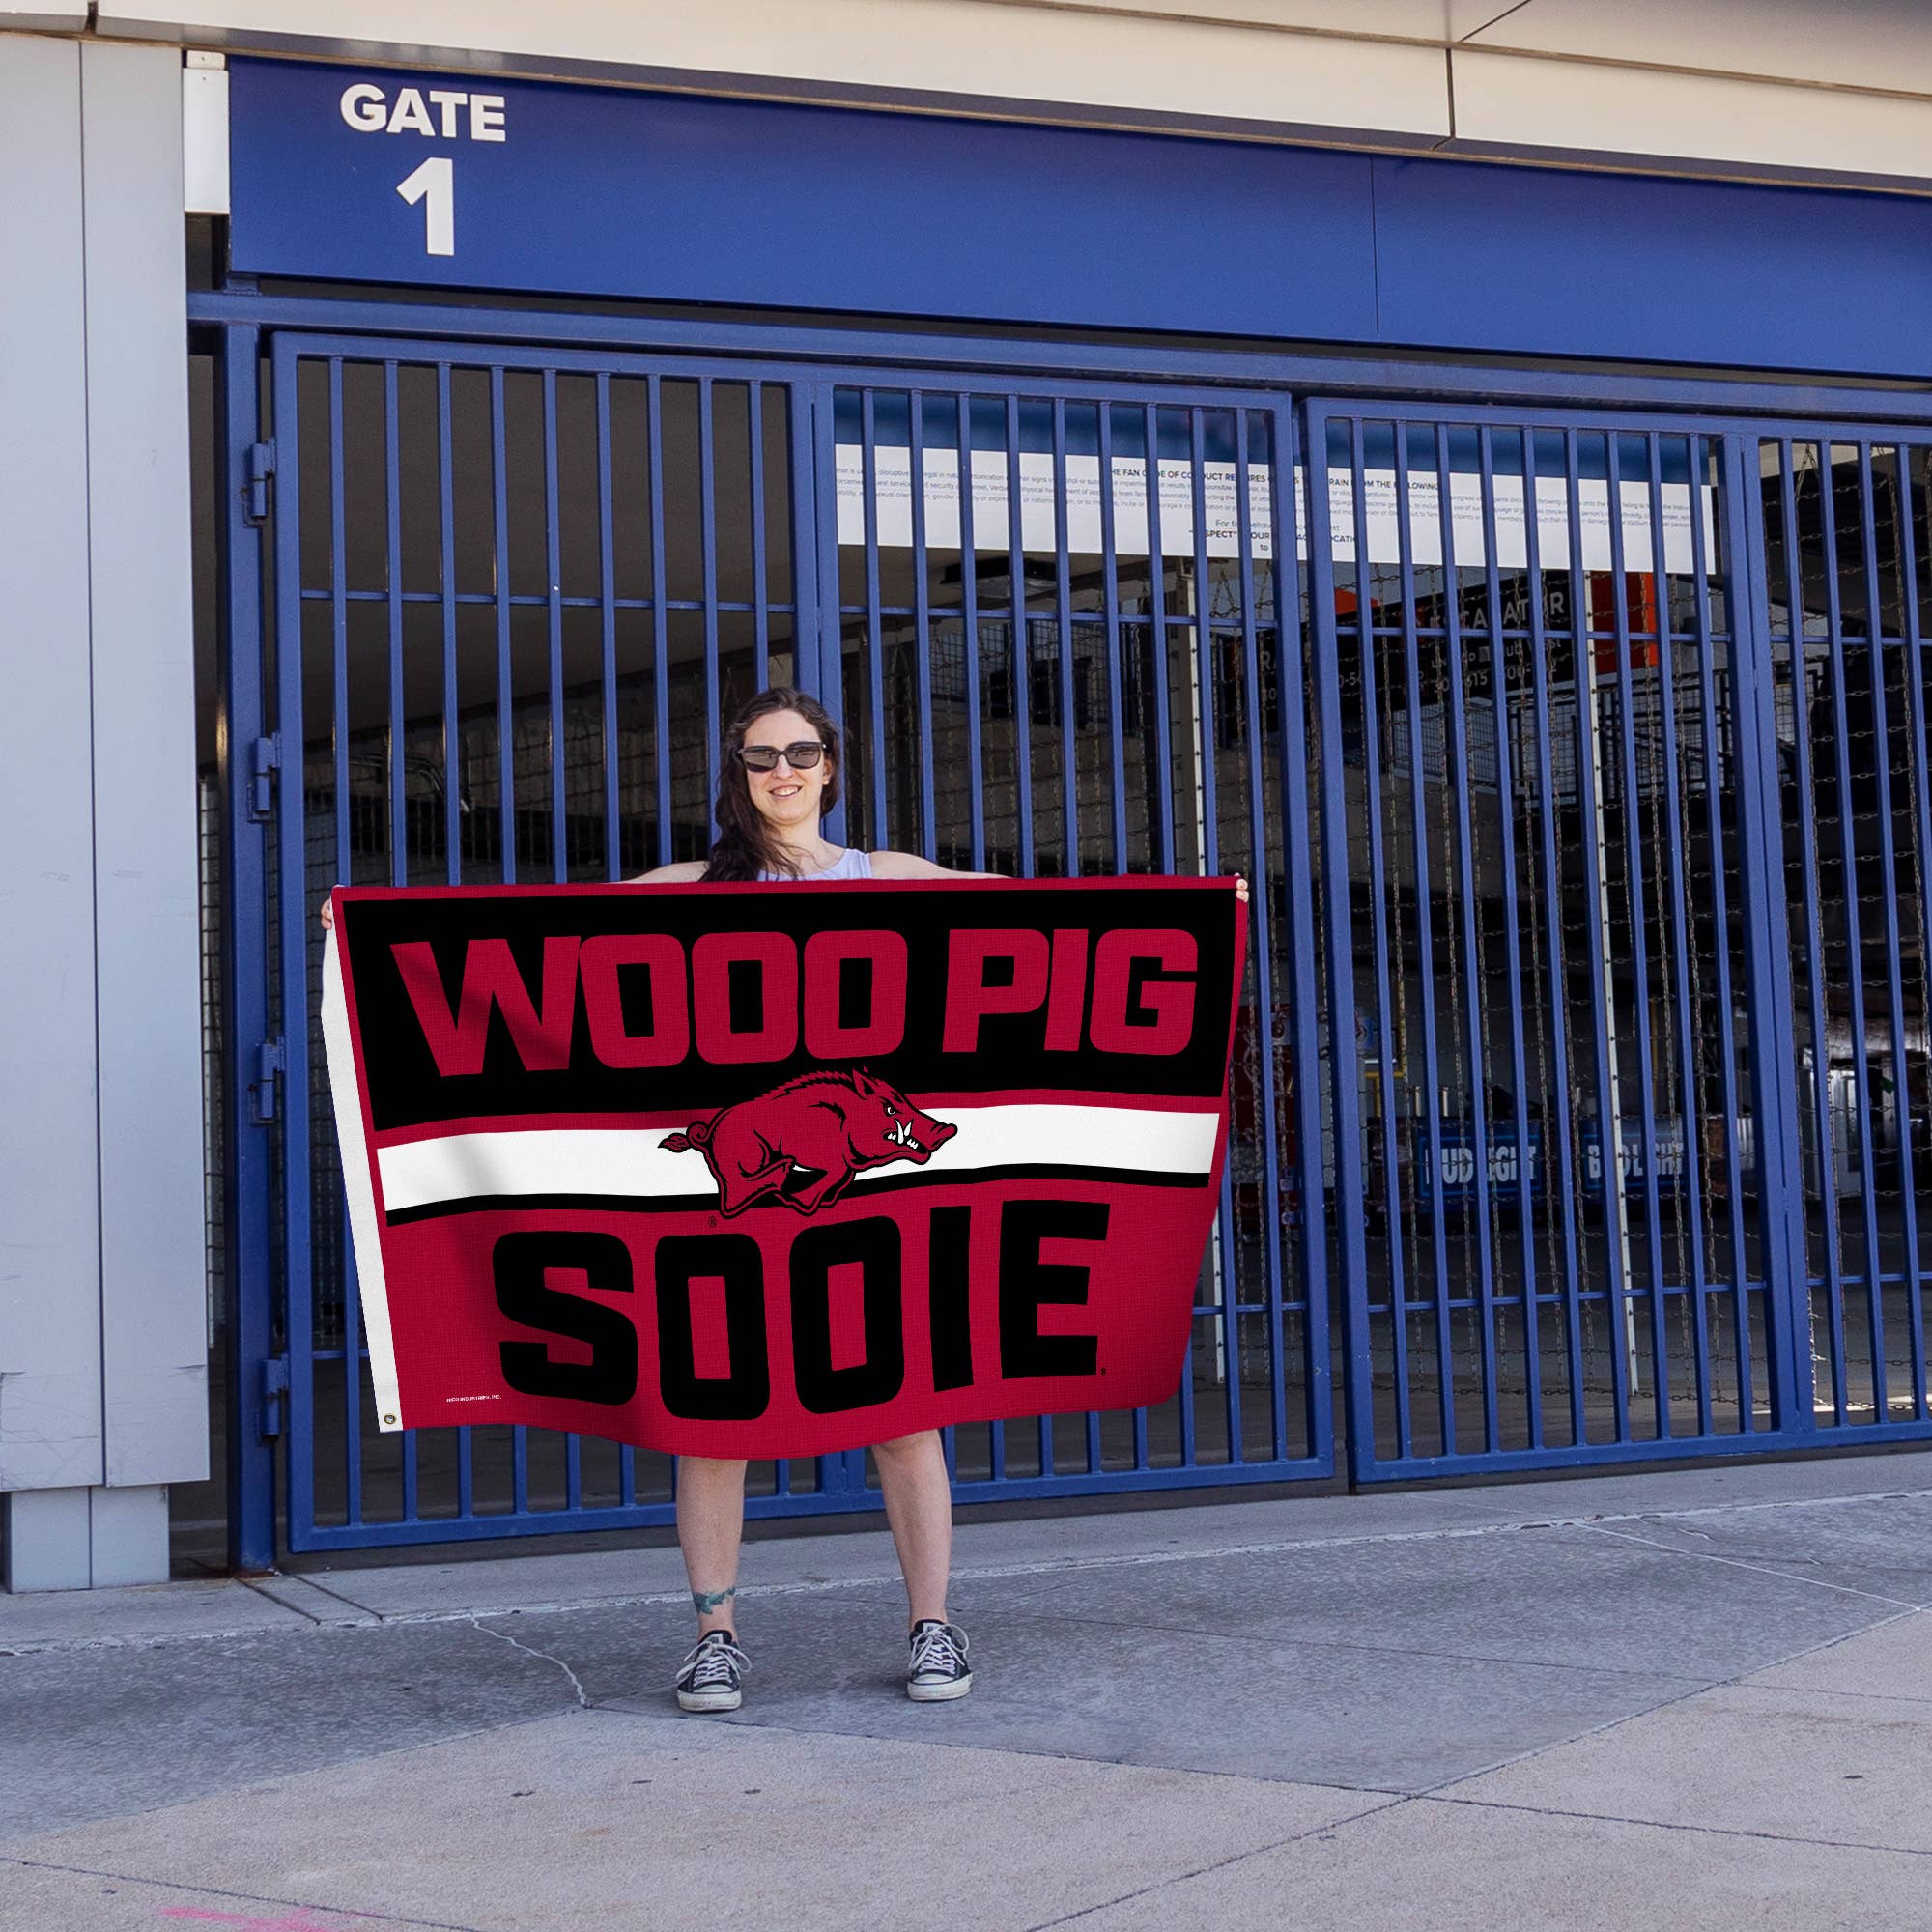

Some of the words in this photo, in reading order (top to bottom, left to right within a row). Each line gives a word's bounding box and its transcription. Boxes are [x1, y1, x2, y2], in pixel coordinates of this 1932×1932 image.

[340, 83, 506, 142] GATE
[396, 157, 455, 256] 1
[389, 930, 908, 1077] WOOO
[943, 928, 1199, 1055] PIG
[492, 1199, 1111, 1421] SOOIE
